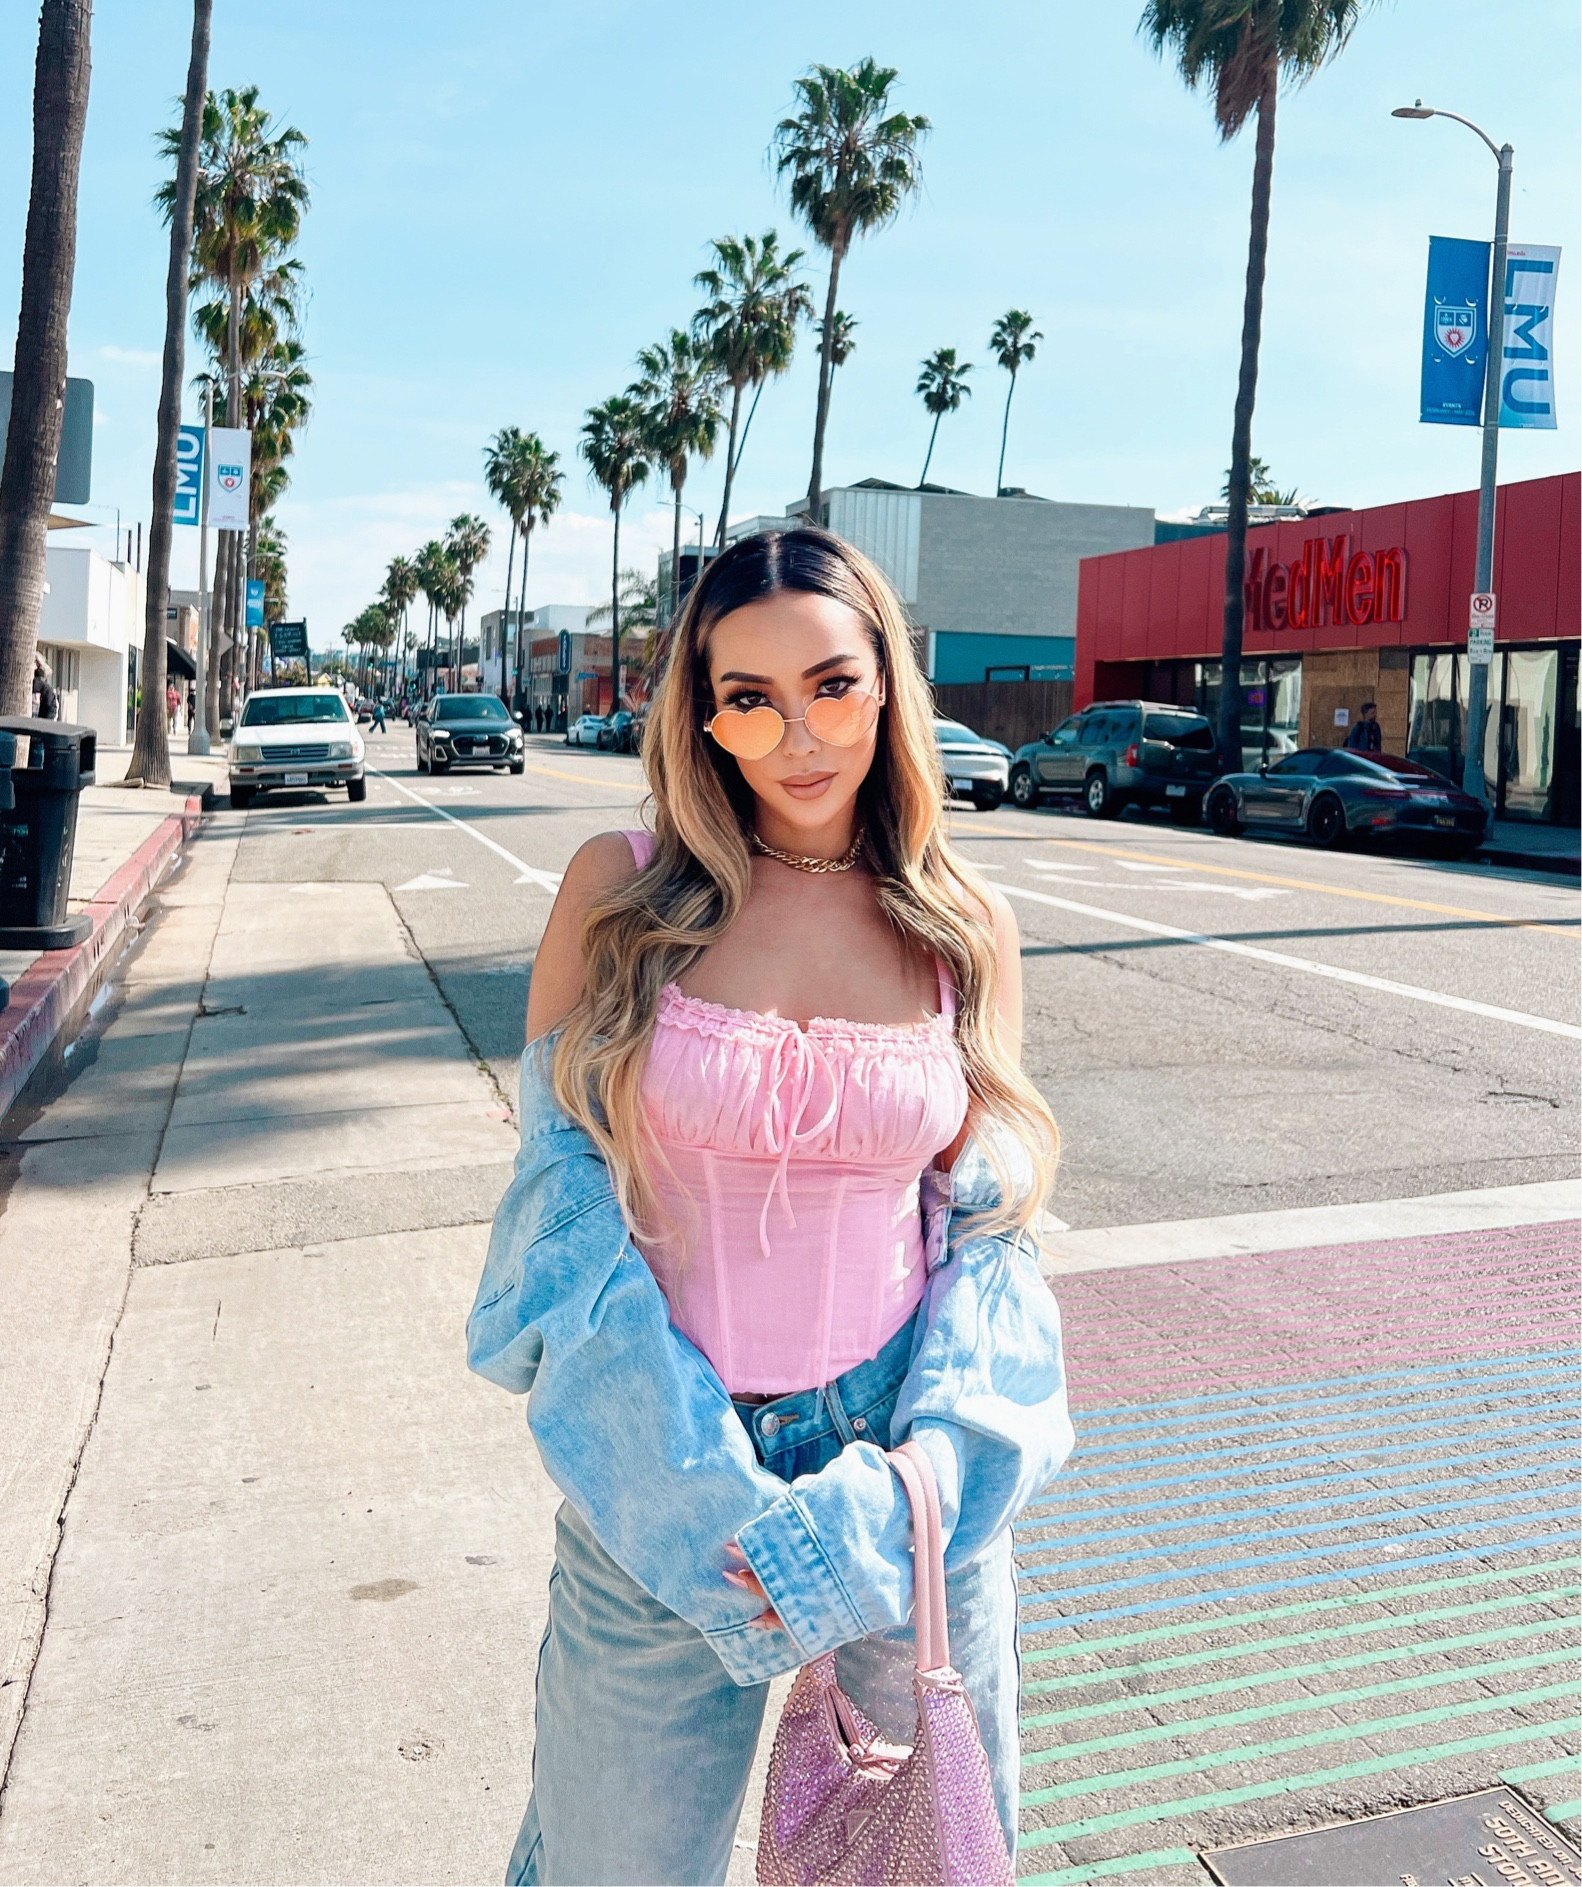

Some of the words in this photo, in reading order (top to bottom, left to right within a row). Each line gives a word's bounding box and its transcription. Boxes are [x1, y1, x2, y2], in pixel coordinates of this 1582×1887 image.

[1503, 259, 1554, 415] LMU
[173, 432, 200, 519] LMU
[1485, 1816, 1538, 1859] 50TH
[1498, 1800, 1557, 1850] DEDICATED
